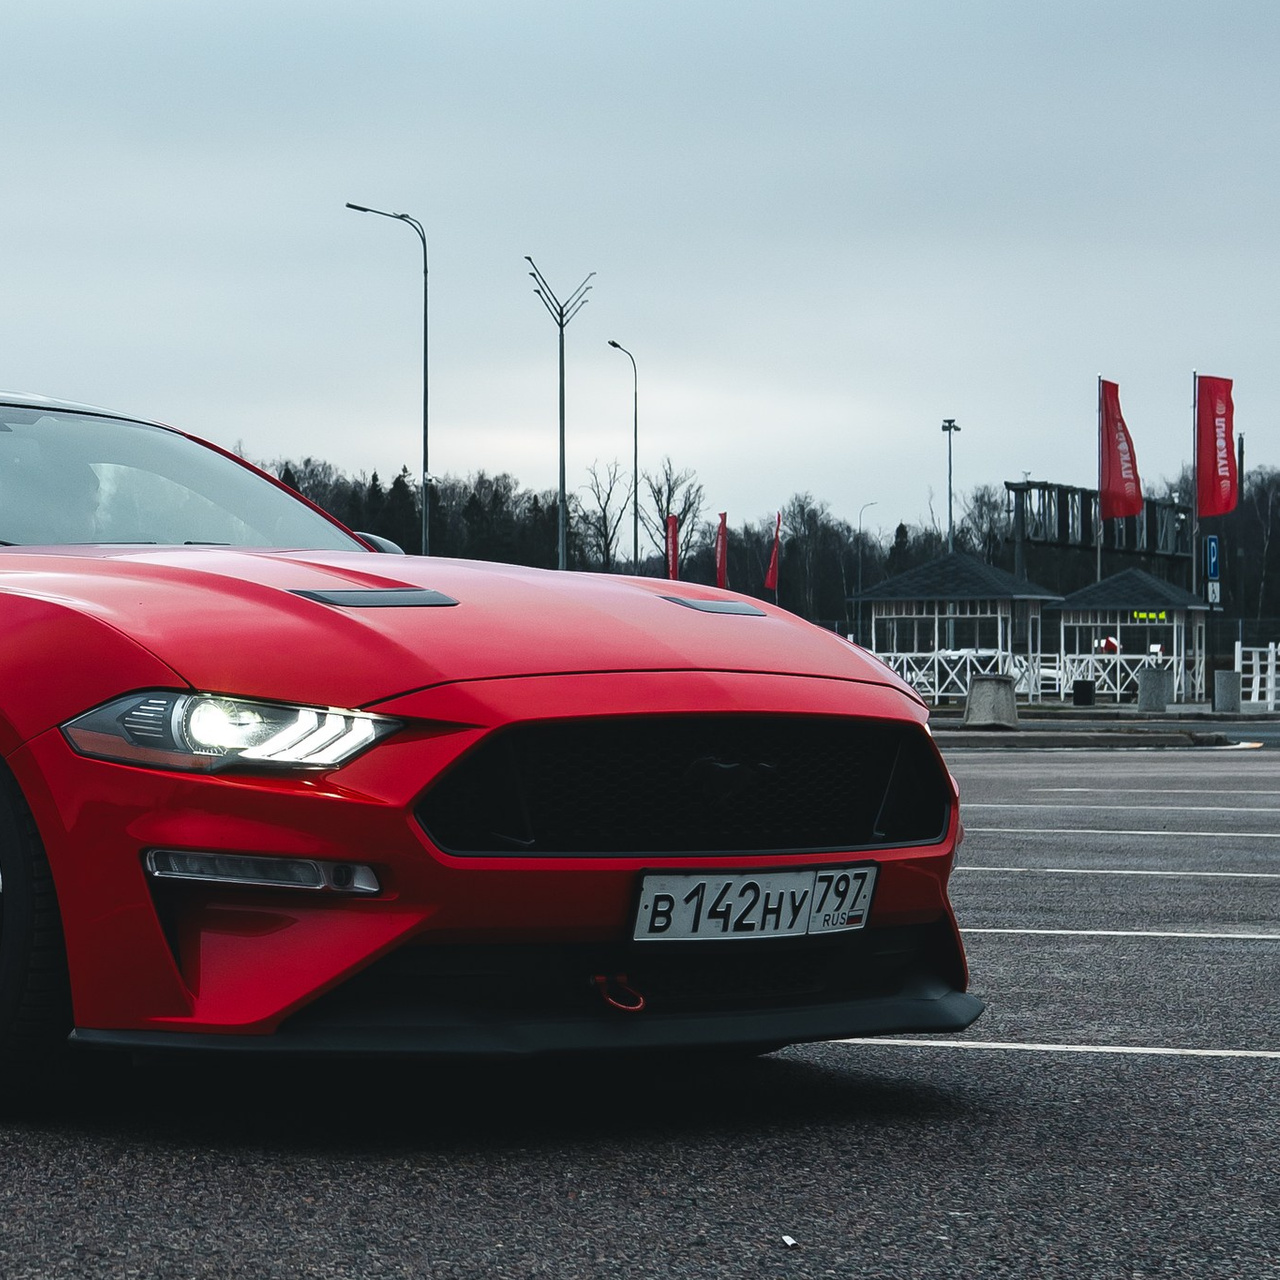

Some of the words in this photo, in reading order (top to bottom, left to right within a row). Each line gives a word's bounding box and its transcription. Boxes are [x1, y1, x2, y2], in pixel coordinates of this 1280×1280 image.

[1210, 541, 1217, 574] P
[816, 871, 868, 914] 797
[822, 912, 847, 928] RUS
